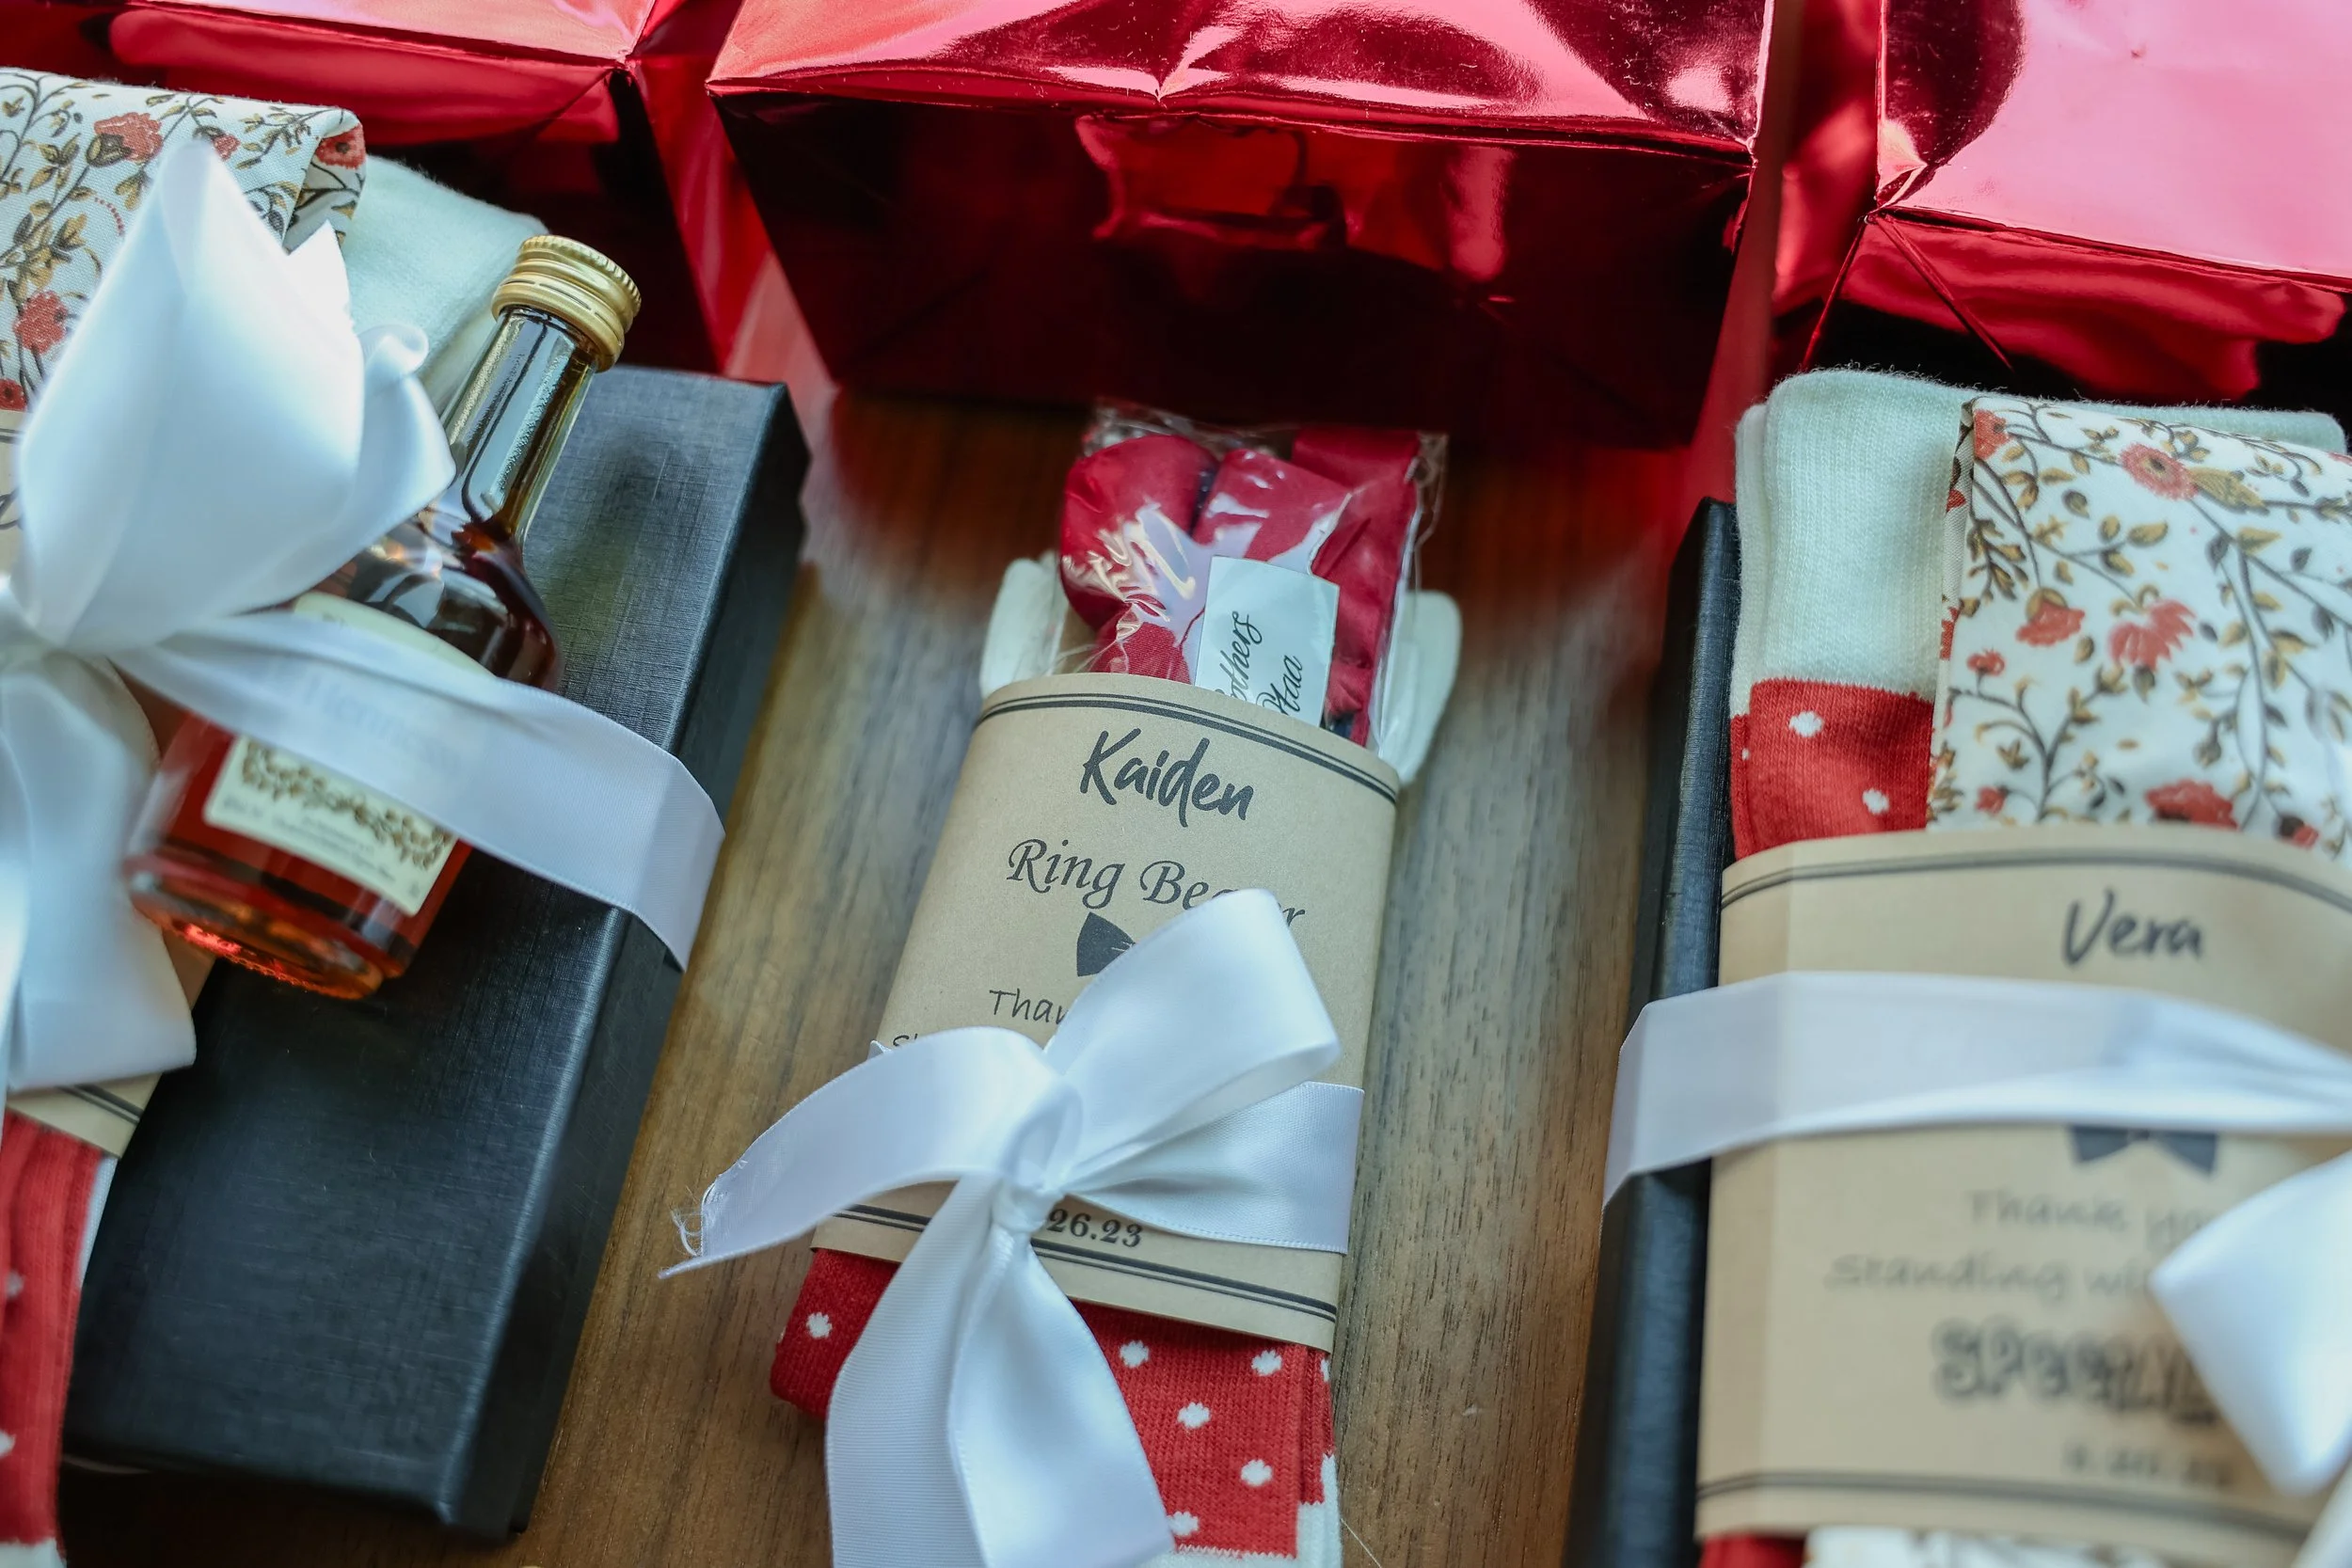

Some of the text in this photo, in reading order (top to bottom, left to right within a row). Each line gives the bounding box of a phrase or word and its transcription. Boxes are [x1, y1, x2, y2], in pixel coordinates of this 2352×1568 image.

[1079, 727, 1254, 829] Kaiden
[1006, 838, 1306, 927] Ring Ber
[2062, 886, 2202, 969] Vera
